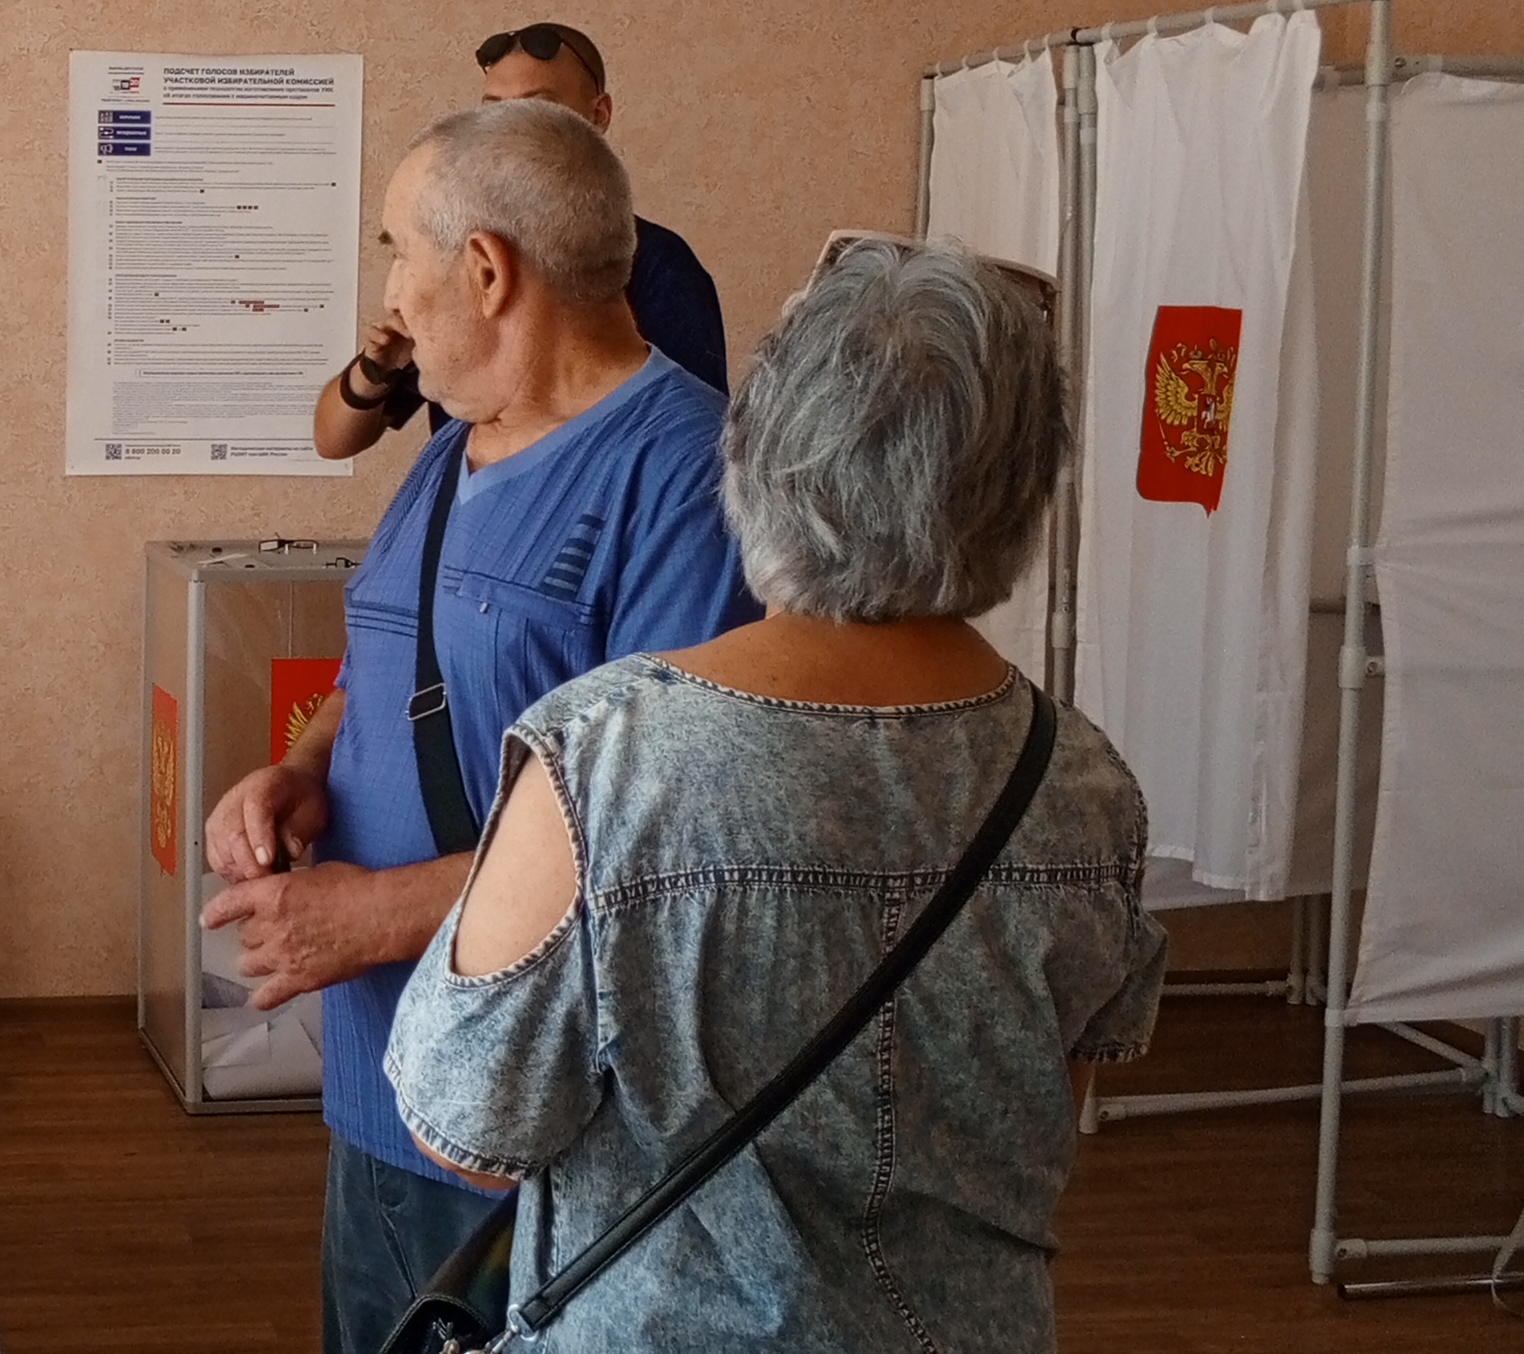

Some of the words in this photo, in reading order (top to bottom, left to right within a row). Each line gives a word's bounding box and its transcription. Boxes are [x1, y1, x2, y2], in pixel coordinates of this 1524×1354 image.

[201, 68, 237, 76] ГОЛОСОВ
[240, 67, 294, 76] ИЗБИРАТЕЛЕЙ
[217, 76, 284, 85] ИЗБИРАТЕЛЬНОЙ
[286, 77, 334, 86] КОМИССИЕЙ
